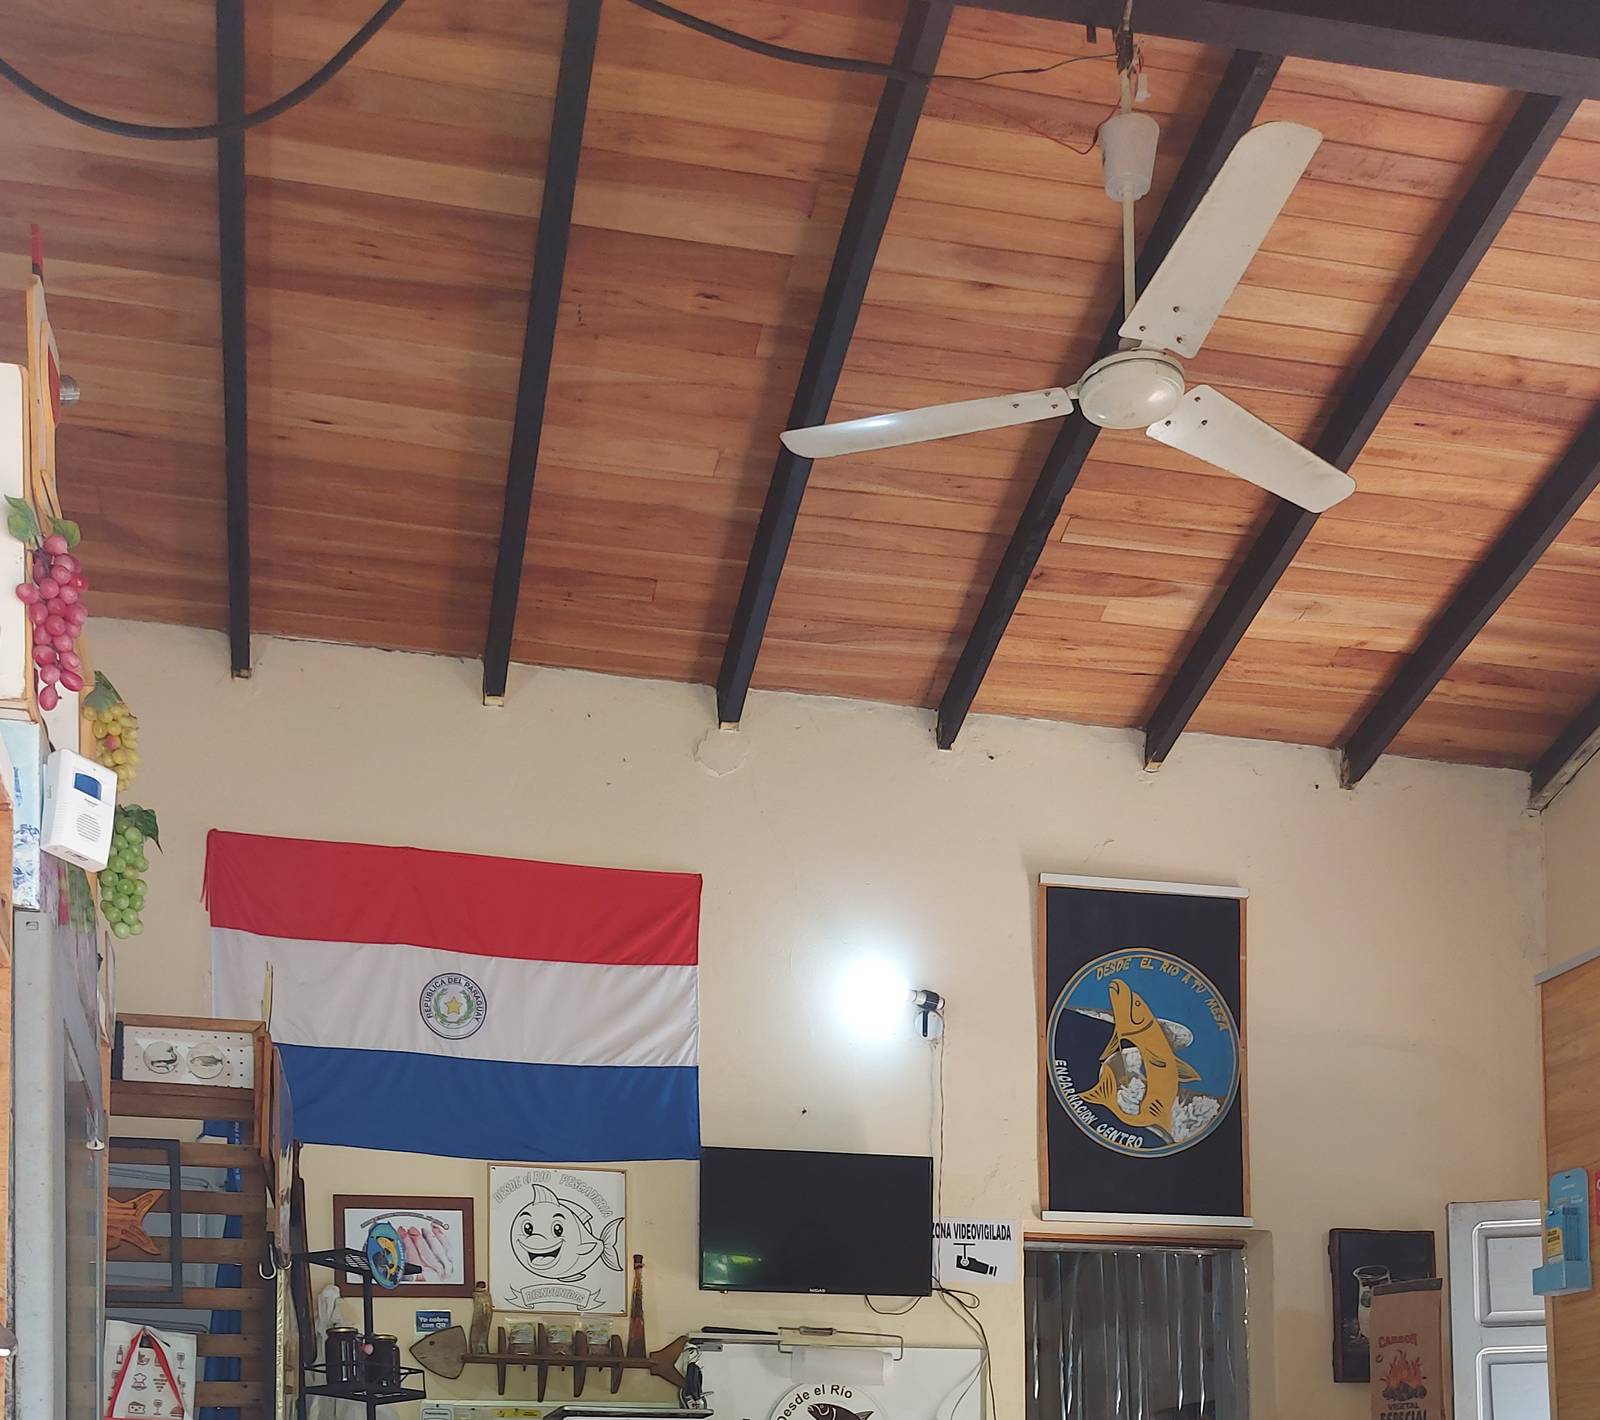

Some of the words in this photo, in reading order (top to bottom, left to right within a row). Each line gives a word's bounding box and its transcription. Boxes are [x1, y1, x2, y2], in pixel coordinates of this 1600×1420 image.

[424, 979, 446, 1019] REPUBLICA
[464, 981, 483, 1022] PARAGUAY
[1096, 958, 1132, 981] DESDE
[1140, 958, 1154, 970] EL
[1159, 960, 1180, 977] RIO
[1181, 973, 1190, 985] A
[1191, 978, 1207, 994] TU
[1204, 998, 1228, 1031] MESA
[1055, 1059, 1097, 1125] ENCARNACION
[1097, 1123, 1144, 1148] CENTRO
[494, 1175, 522, 1204] DESDE
[932, 1222, 952, 1239] ZONA
[953, 1223, 1012, 1241] VIDEOVIGILADA
[525, 1287, 586, 1303] BIENVENIDOS
[814, 1384, 825, 1395] el
[830, 1384, 853, 1399] Río
